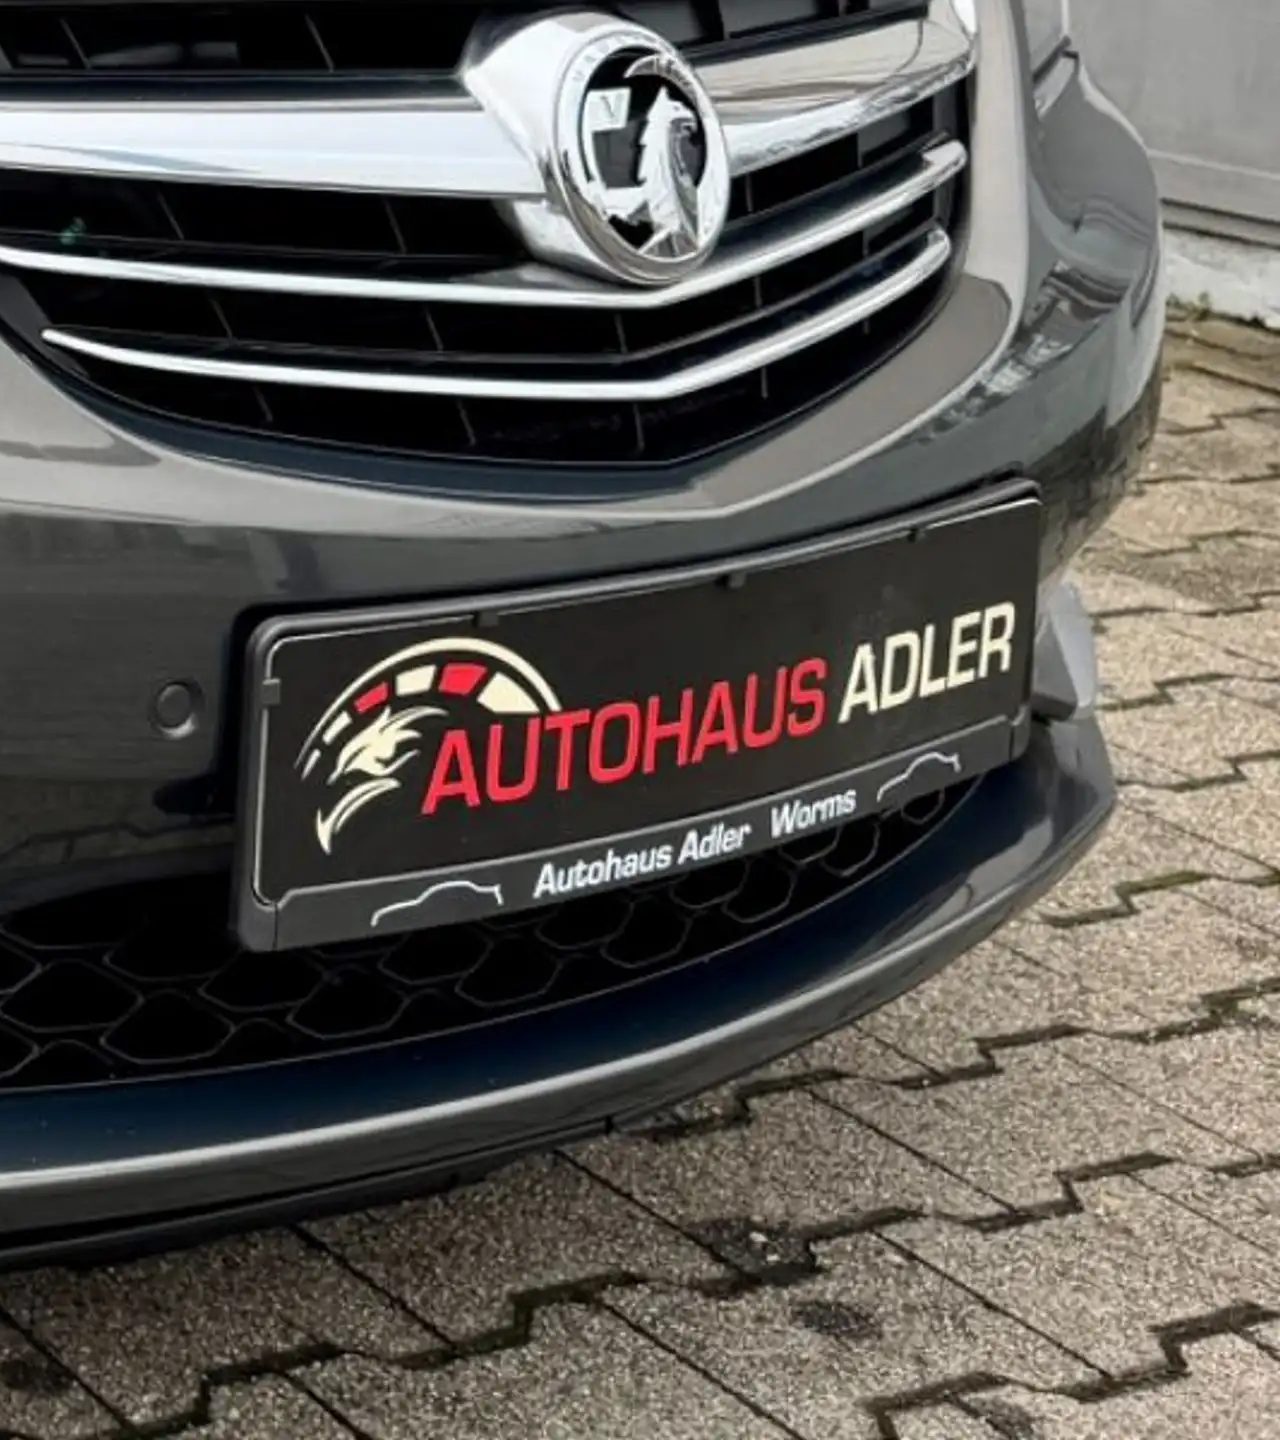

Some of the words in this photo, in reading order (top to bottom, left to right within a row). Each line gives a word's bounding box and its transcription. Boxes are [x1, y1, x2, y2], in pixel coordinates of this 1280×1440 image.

[421, 657, 828, 815] AUTOHAUS
[838, 601, 1016, 724] ADLER
[533, 840, 673, 899] Autohaus
[678, 822, 753, 865] Adler
[770, 786, 857, 839] Worms
